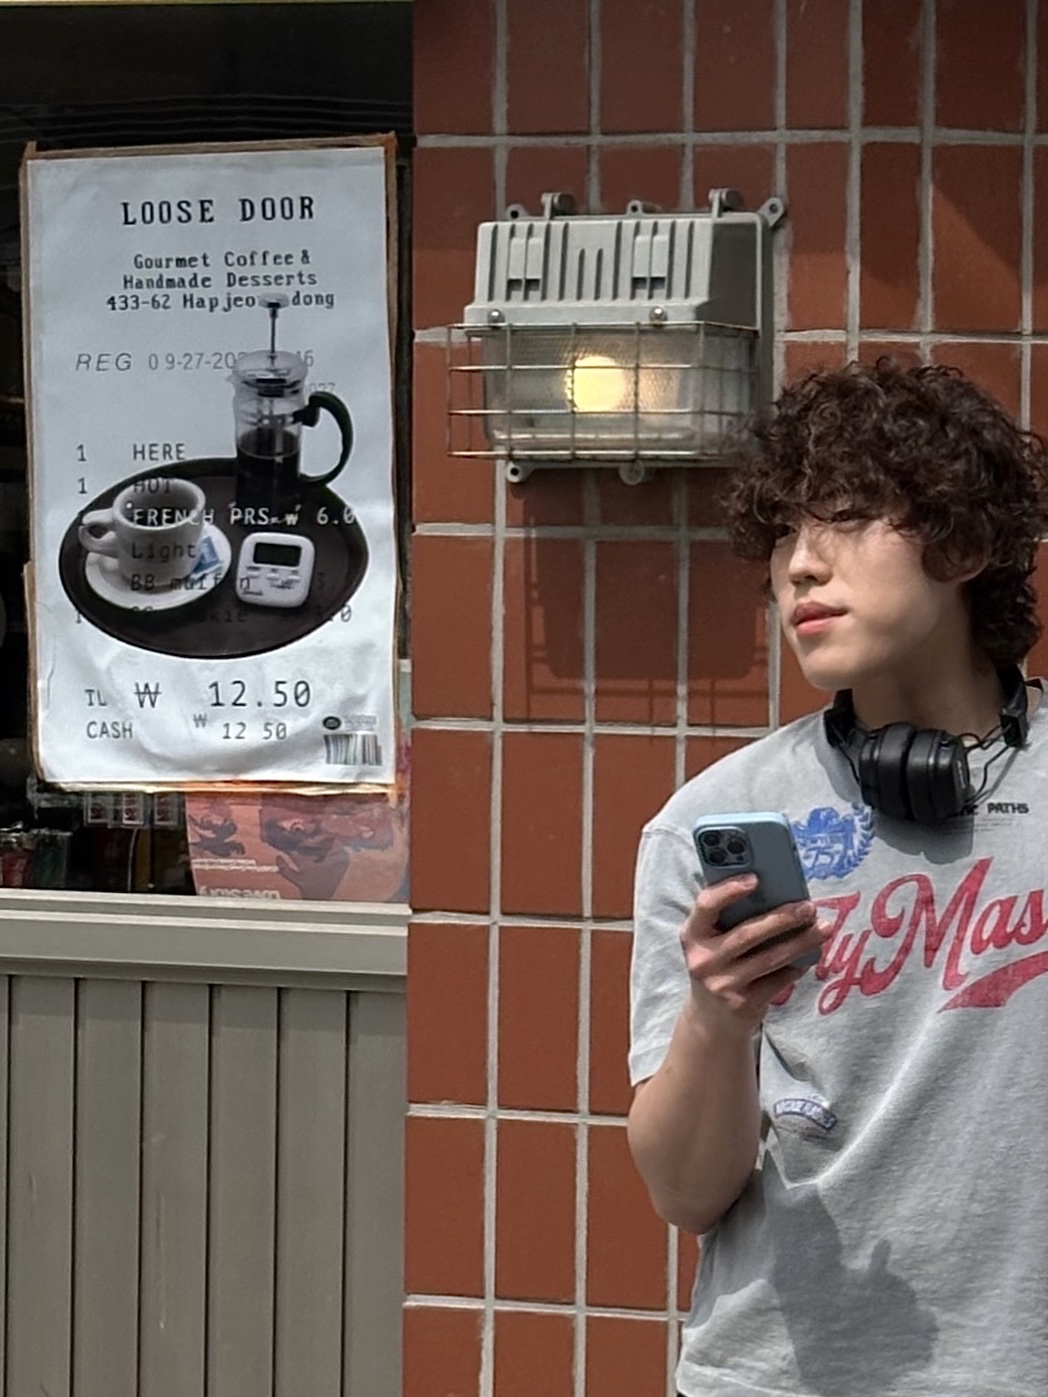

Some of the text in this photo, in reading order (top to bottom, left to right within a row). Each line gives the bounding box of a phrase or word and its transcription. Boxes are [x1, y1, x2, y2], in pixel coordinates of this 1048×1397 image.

[122, 195, 315, 226] LOOSE DOOR
[133, 249, 311, 270] Gourmet Coffee &
[122, 269, 318, 291] Handmade Desserts
[106, 293, 172, 312] 433-62
[75, 352, 133, 372] REG
[77, 443, 187, 462] 1 HERE
[78, 477, 88, 494] 1
[130, 542, 198, 563] Light
[130, 573, 156, 592] BB
[84, 689, 108, 707] TL
[208, 680, 312, 708] 12.50
[86, 720, 133, 740] CASH
